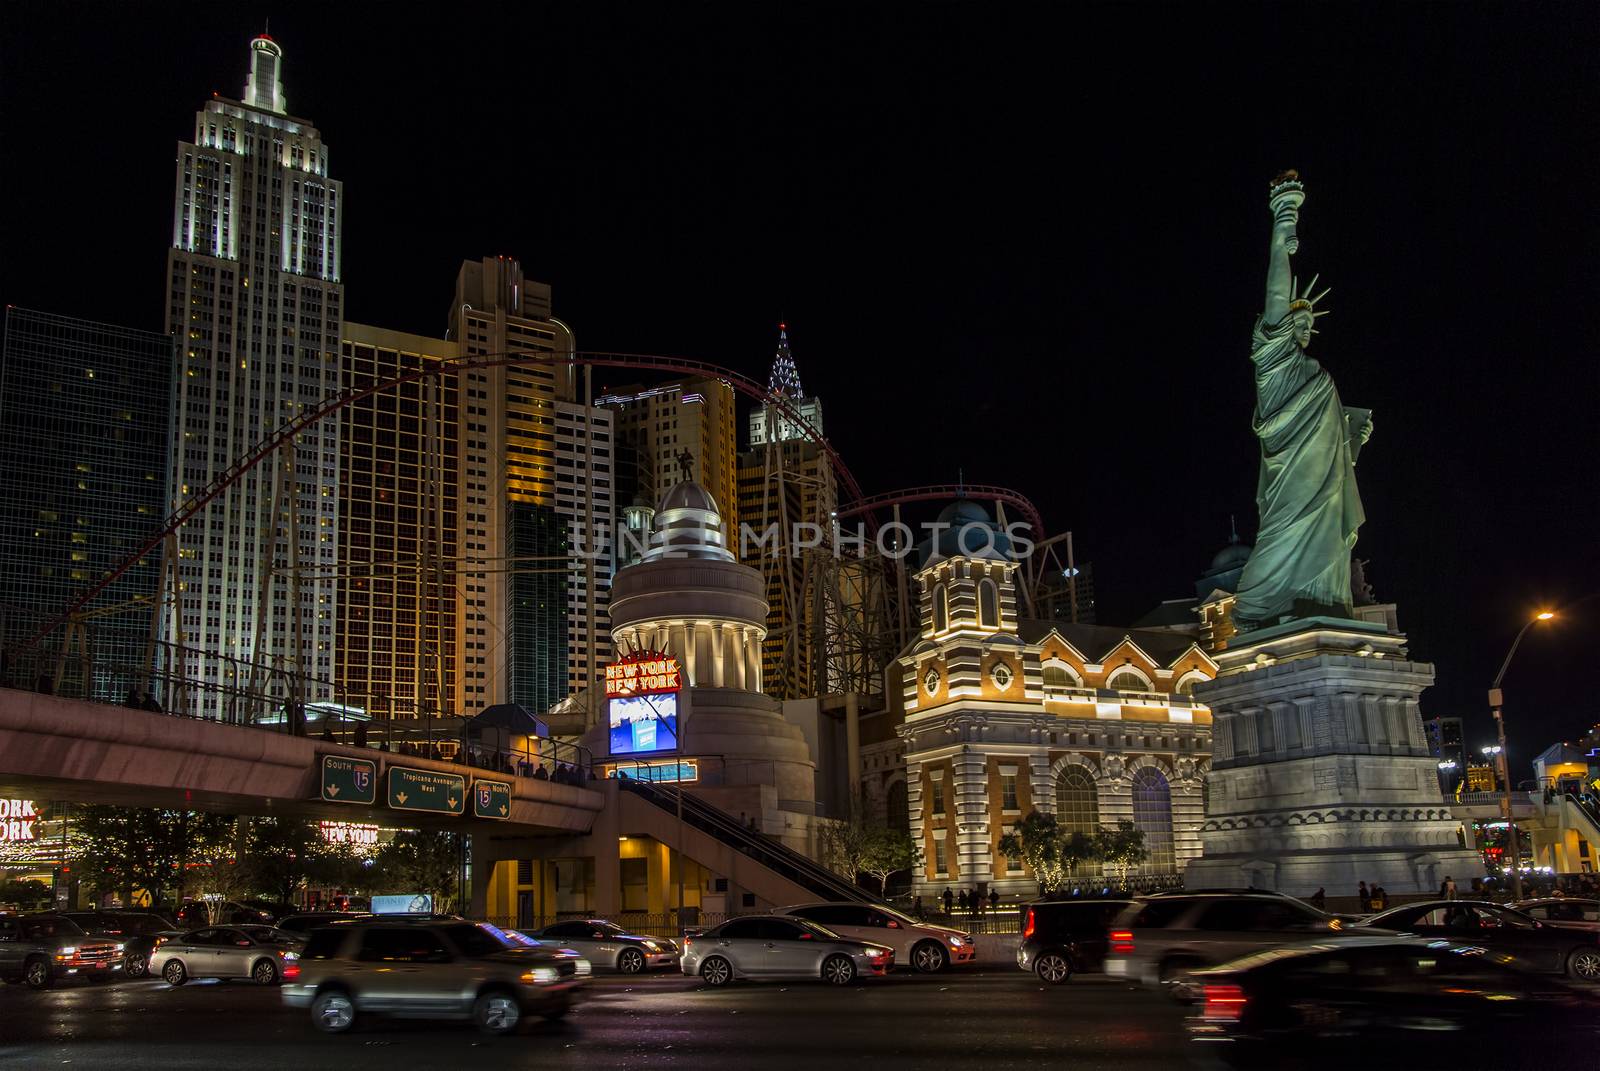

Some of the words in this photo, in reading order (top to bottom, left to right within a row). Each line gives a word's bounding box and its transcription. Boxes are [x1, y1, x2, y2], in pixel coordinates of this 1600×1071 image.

[606, 663, 638, 679] NEW
[639, 659, 678, 676] YORK
[606, 677, 638, 693] NEW
[639, 673, 678, 690] YORK
[326, 759, 352, 770] SOUTH
[356, 771, 370, 787] 15
[402, 772, 431, 783] Tropicana
[421, 784, 436, 793] West
[479, 790, 489, 803] 15
[348, 829, 379, 844] YORK
